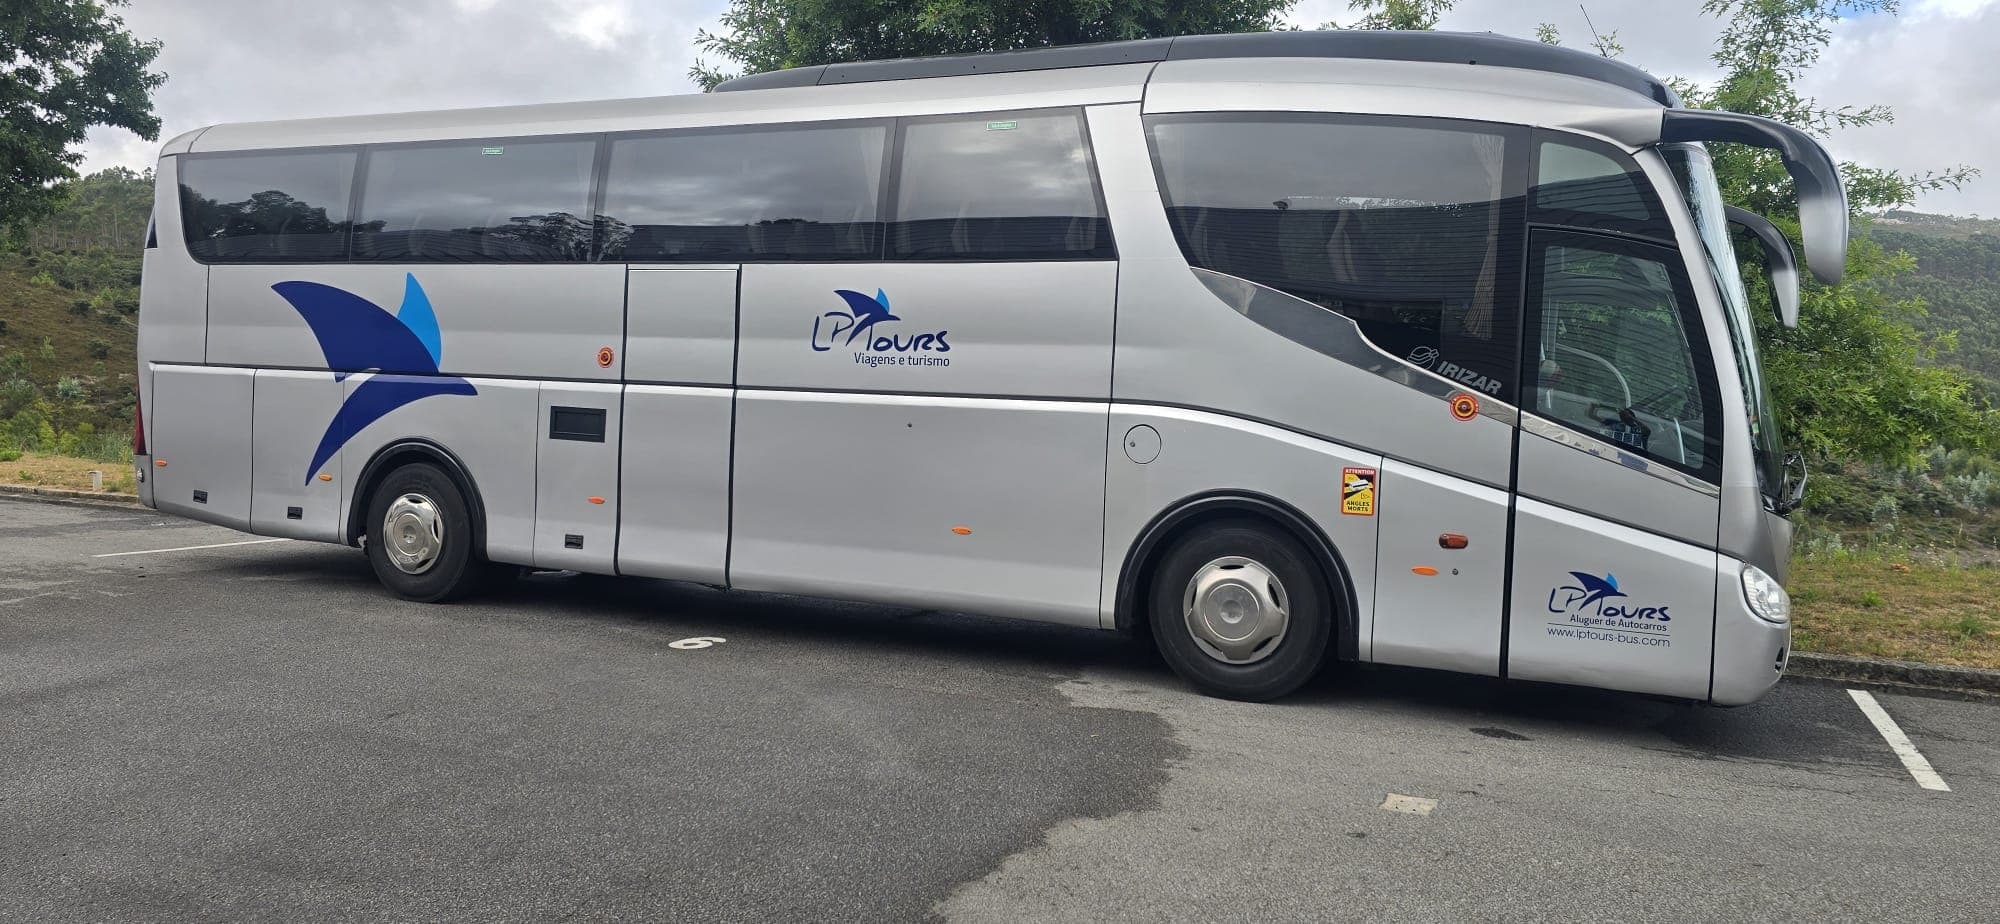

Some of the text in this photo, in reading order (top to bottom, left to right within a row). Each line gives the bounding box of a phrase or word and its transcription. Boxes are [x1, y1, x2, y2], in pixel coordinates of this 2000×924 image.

[854, 352, 950, 367] Viagens e turismo
[1437, 361, 1502, 394] IRIZAR
[1569, 613, 1667, 632] Aluguer de Autocarros
[1547, 627, 1671, 648] www.lptours-bus.com
